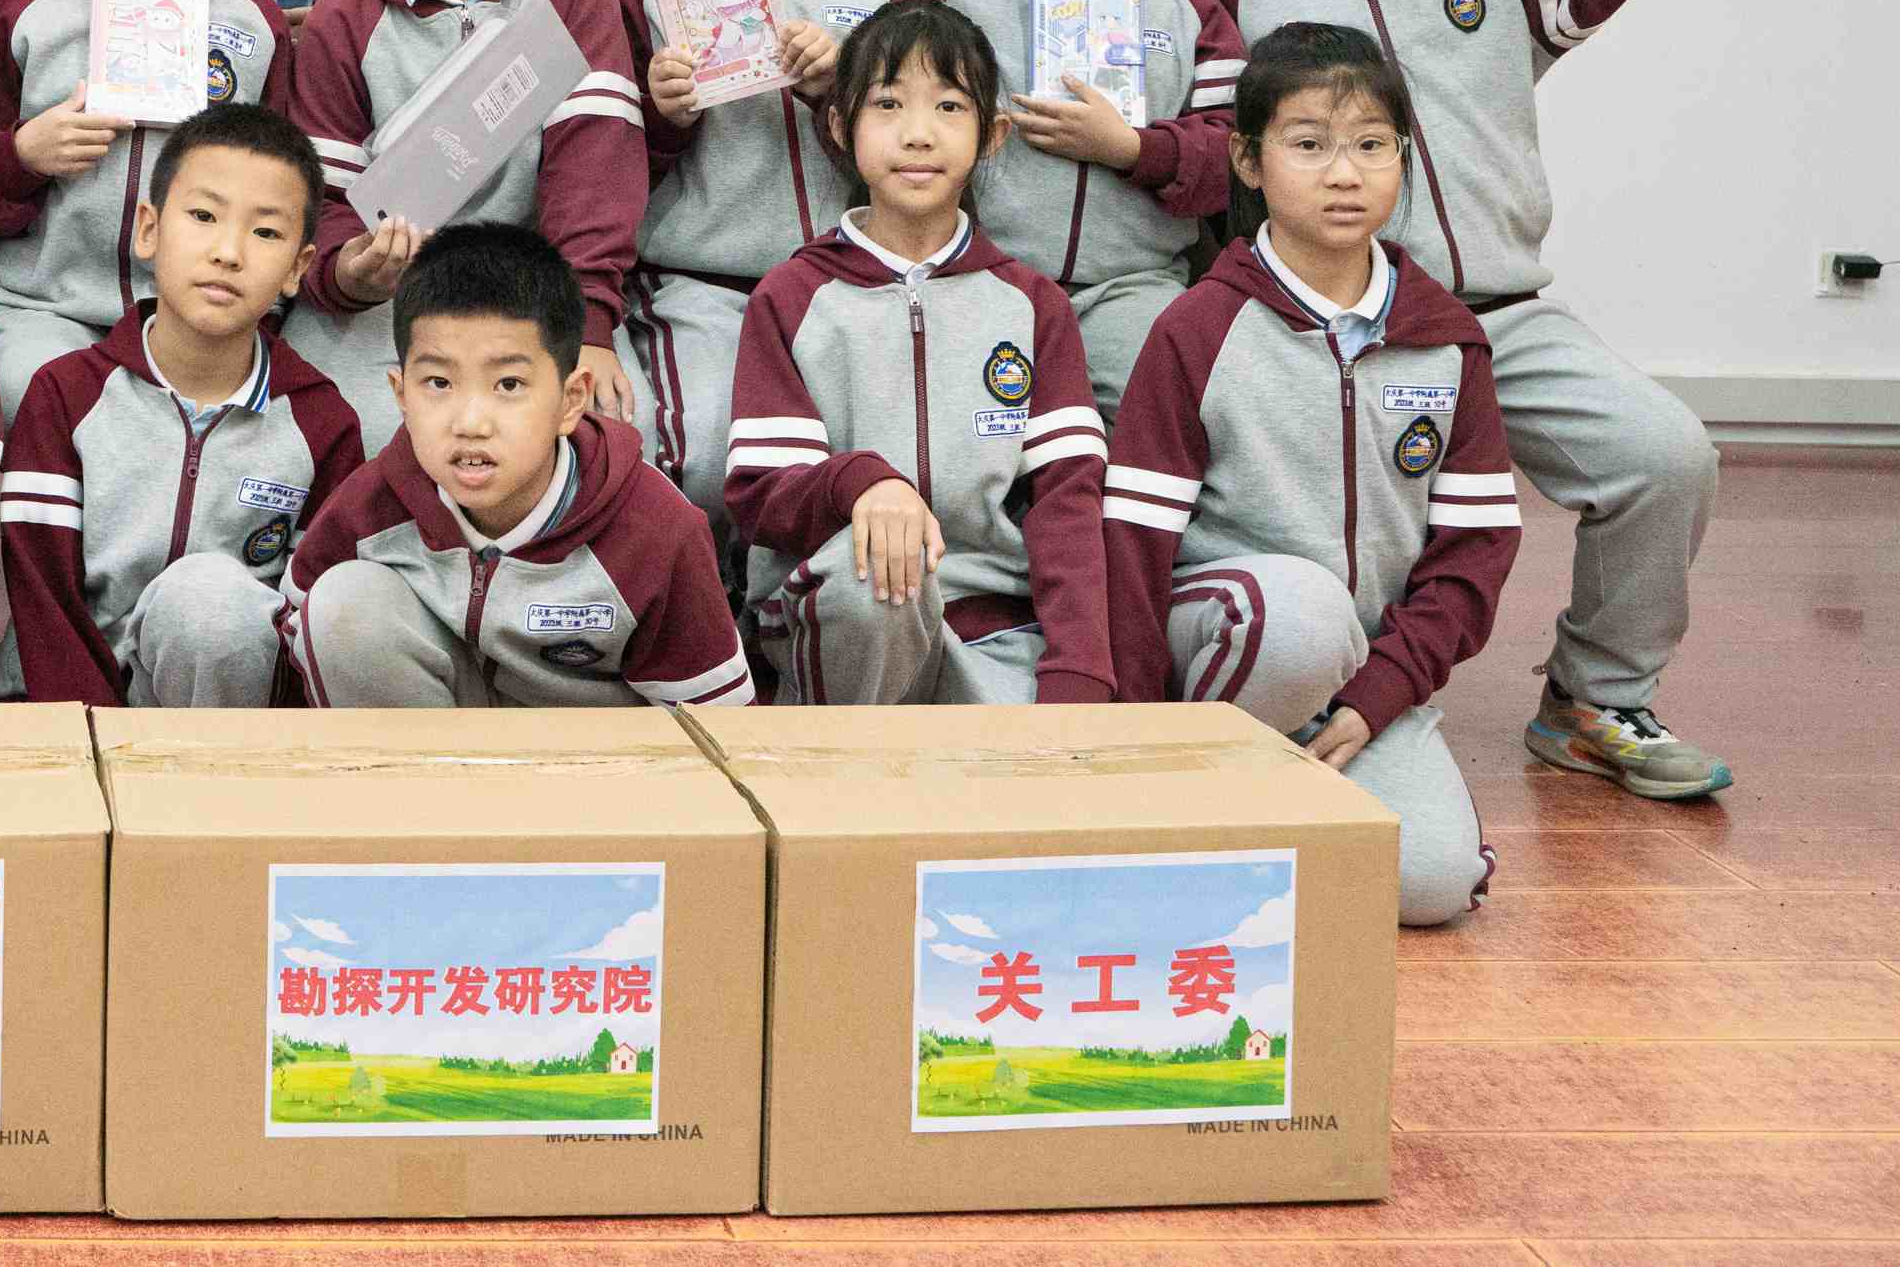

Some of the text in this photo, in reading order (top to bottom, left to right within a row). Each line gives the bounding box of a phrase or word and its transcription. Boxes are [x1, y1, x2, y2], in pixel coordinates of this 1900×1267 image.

[277, 966, 653, 1017] 勘探开发研究院
[975, 944, 1237, 1024] 关工委
[1187, 1115, 1339, 1134] MADE IN CHINA
